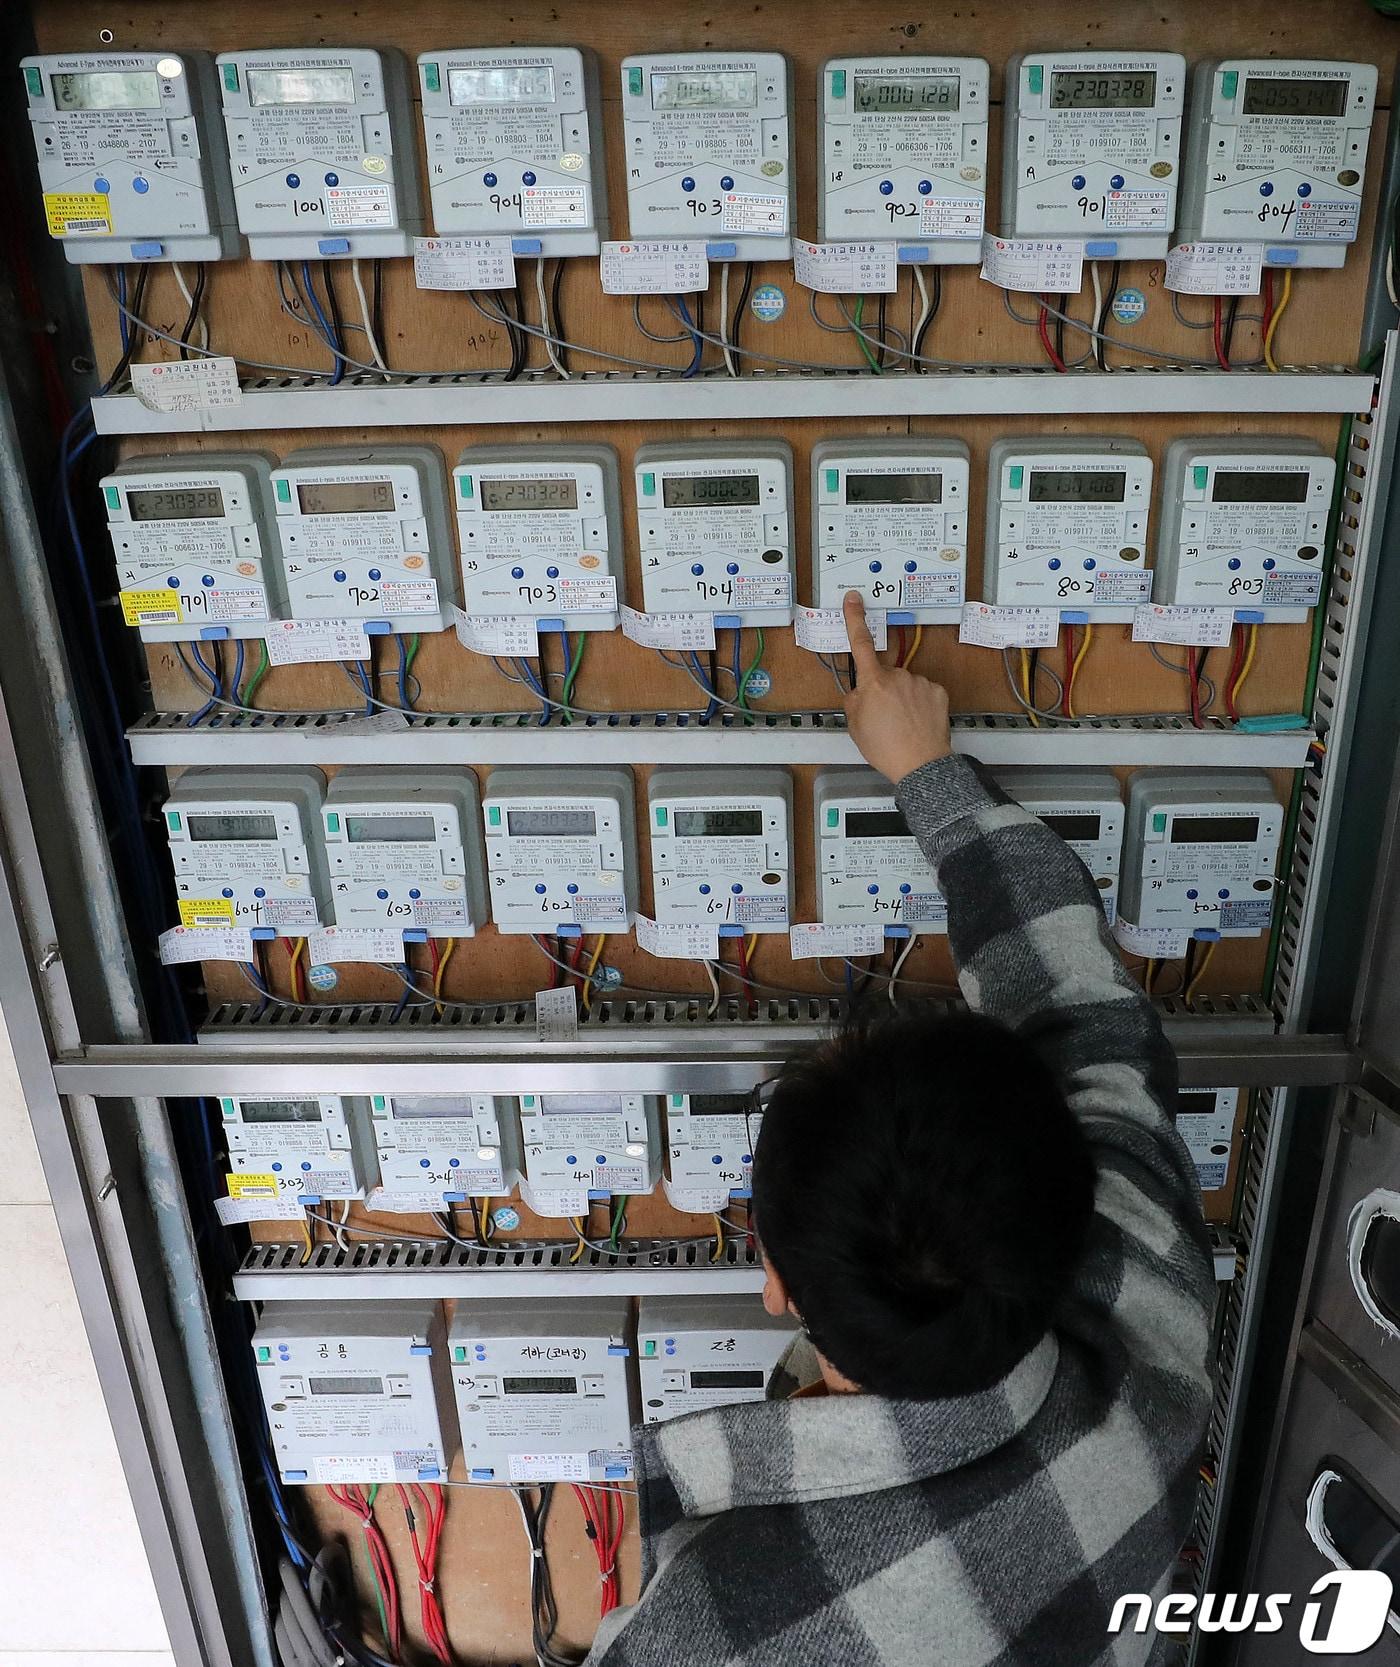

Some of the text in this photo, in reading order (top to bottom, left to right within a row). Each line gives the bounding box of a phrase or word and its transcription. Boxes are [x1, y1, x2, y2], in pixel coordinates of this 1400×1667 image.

[62, 141, 70, 149] 26
[80, 140, 88, 149] 19
[831, 171, 844, 182] 18
[294, 198, 325, 216] 1001
[490, 192, 522, 218] 904
[687, 199, 722, 218] 903
[885, 202, 920, 223] 902
[1077, 196, 1106, 220] 901
[1258, 200, 1296, 233] 804
[519, 585, 556, 604] 703
[697, 580, 733, 604] 704
[872, 580, 903, 606] 801
[1058, 577, 1095, 597] 802
[1228, 578, 1263, 595] 803
[181, 590, 207, 614] 701
[349, 588, 380, 606] 702
[234, 903, 263, 924] 604
[386, 901, 412, 917] 603
[541, 898, 572, 913] 602
[706, 898, 731, 920] 601
[873, 899, 902, 918] 504
[1193, 902, 1221, 915] 502
[278, 1178, 305, 1190] 303
[427, 1168, 454, 1185] 304
[573, 1169, 594, 1186] 401
